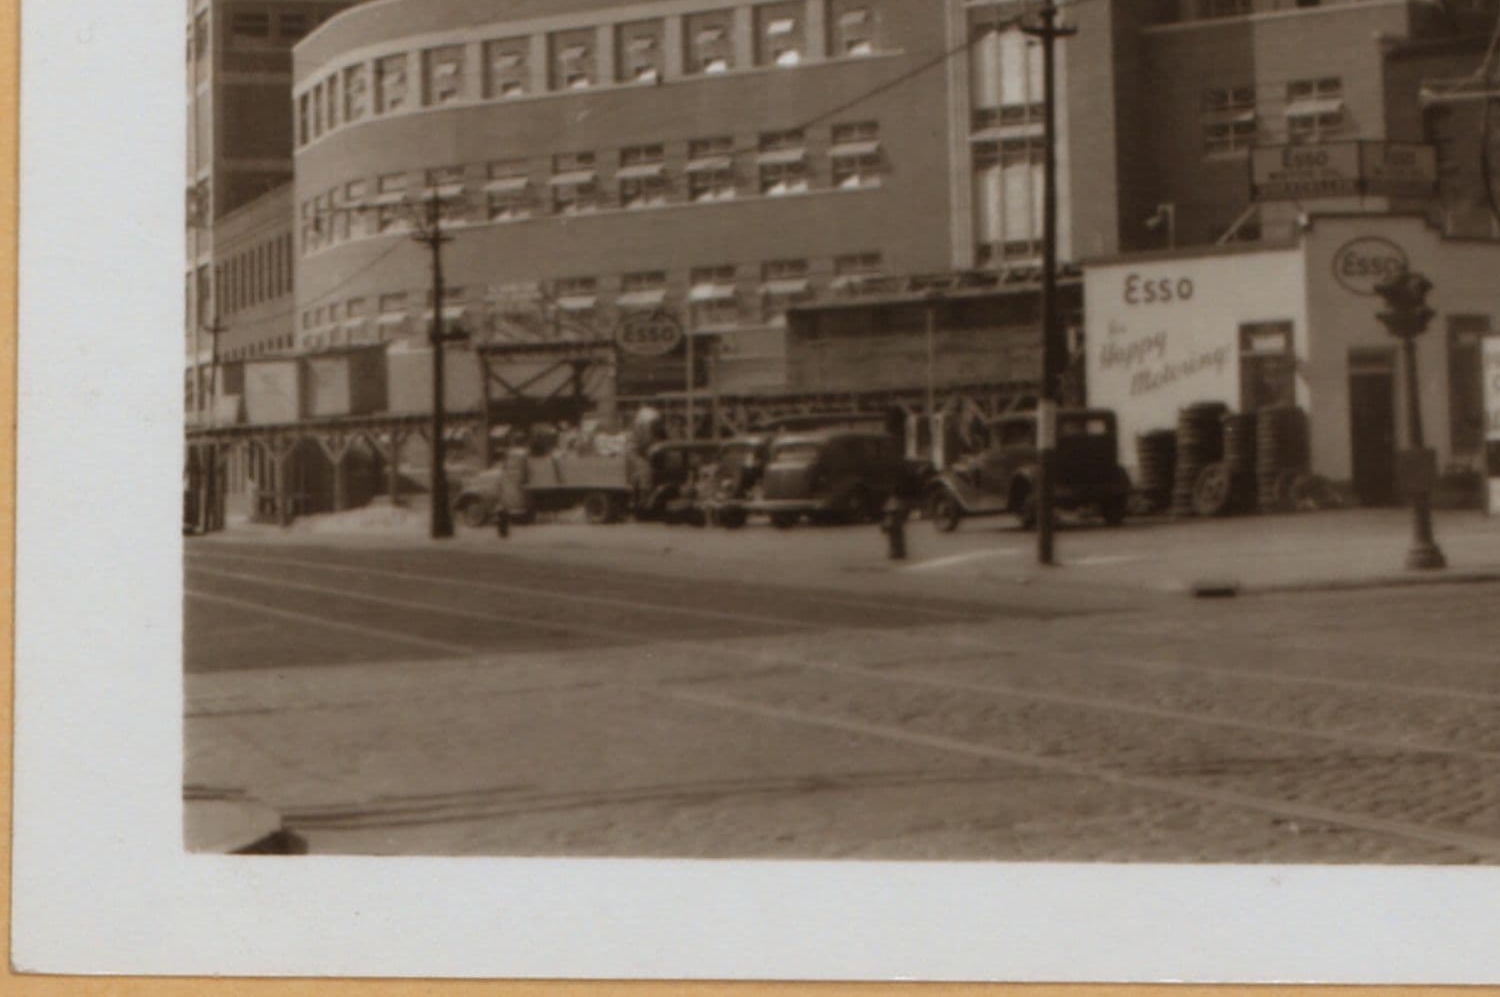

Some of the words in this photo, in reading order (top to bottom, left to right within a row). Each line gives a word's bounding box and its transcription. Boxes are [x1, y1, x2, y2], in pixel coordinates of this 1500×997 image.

[1342, 249, 1399, 279] Esso
[1123, 272, 1196, 306] Esso
[623, 321, 675, 343] Esso
[1099, 329, 1168, 370] Happy
